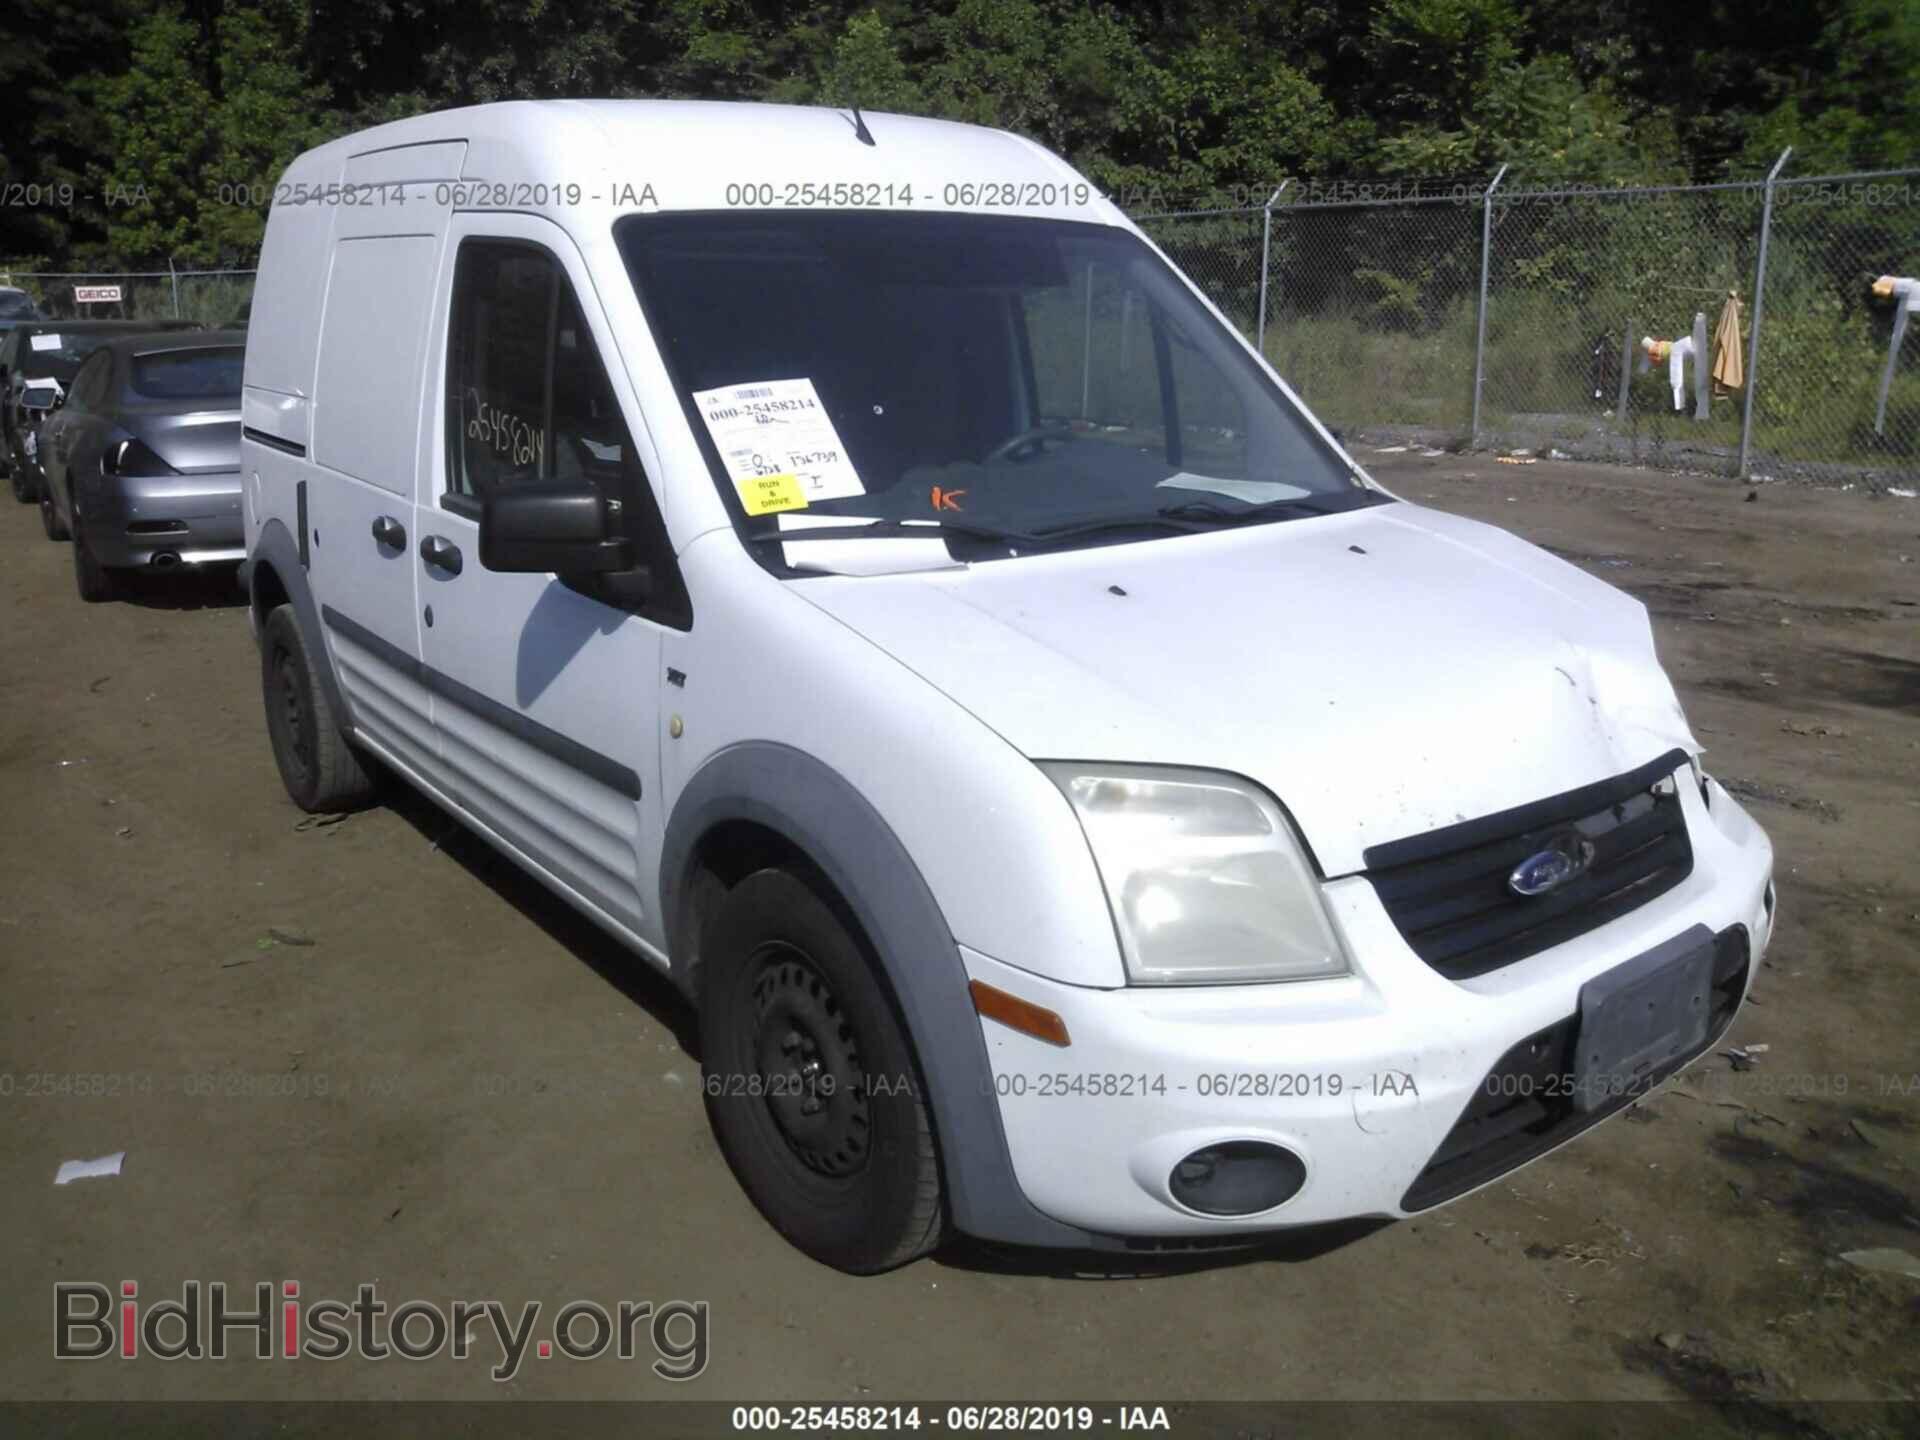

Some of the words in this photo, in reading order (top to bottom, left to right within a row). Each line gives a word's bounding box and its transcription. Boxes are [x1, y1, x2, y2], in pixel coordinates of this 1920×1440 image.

[79, 289, 118, 299] GEICO
[709, 399, 816, 422] 000-25458214
[758, 480, 780, 489] RUN
[761, 497, 792, 508] DRIVE
